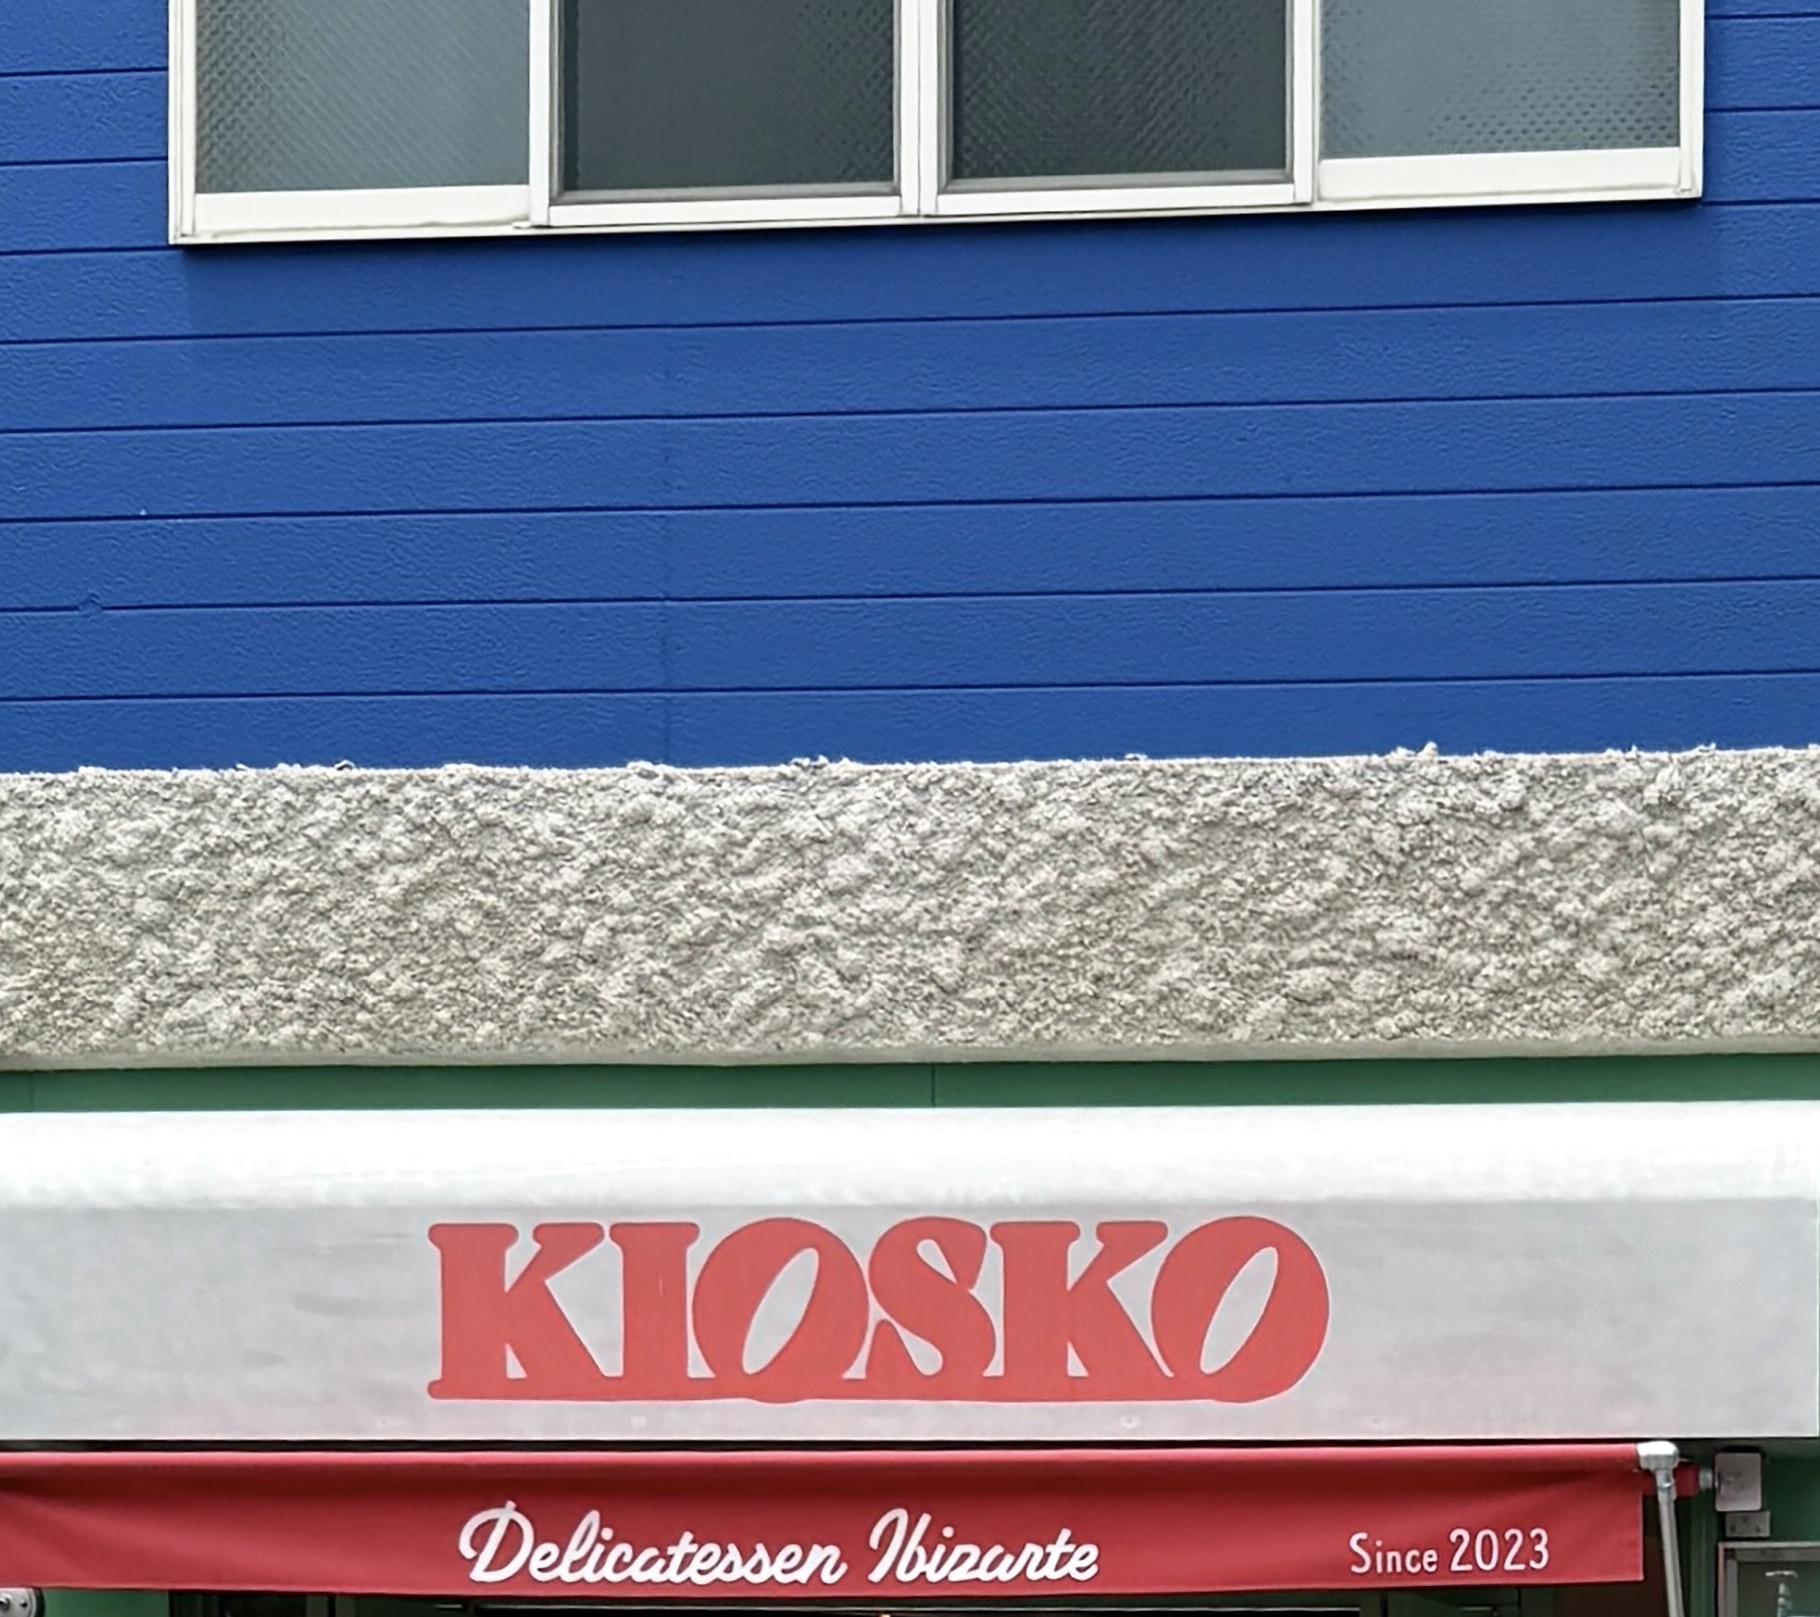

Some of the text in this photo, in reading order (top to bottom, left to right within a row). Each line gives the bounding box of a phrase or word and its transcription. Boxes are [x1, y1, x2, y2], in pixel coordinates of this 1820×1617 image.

[426, 1215, 1330, 1403] KIOSKO
[457, 1501, 1100, 1584] Delicatessen Ibizarte
[1349, 1528, 1549, 1574] Since 2023
